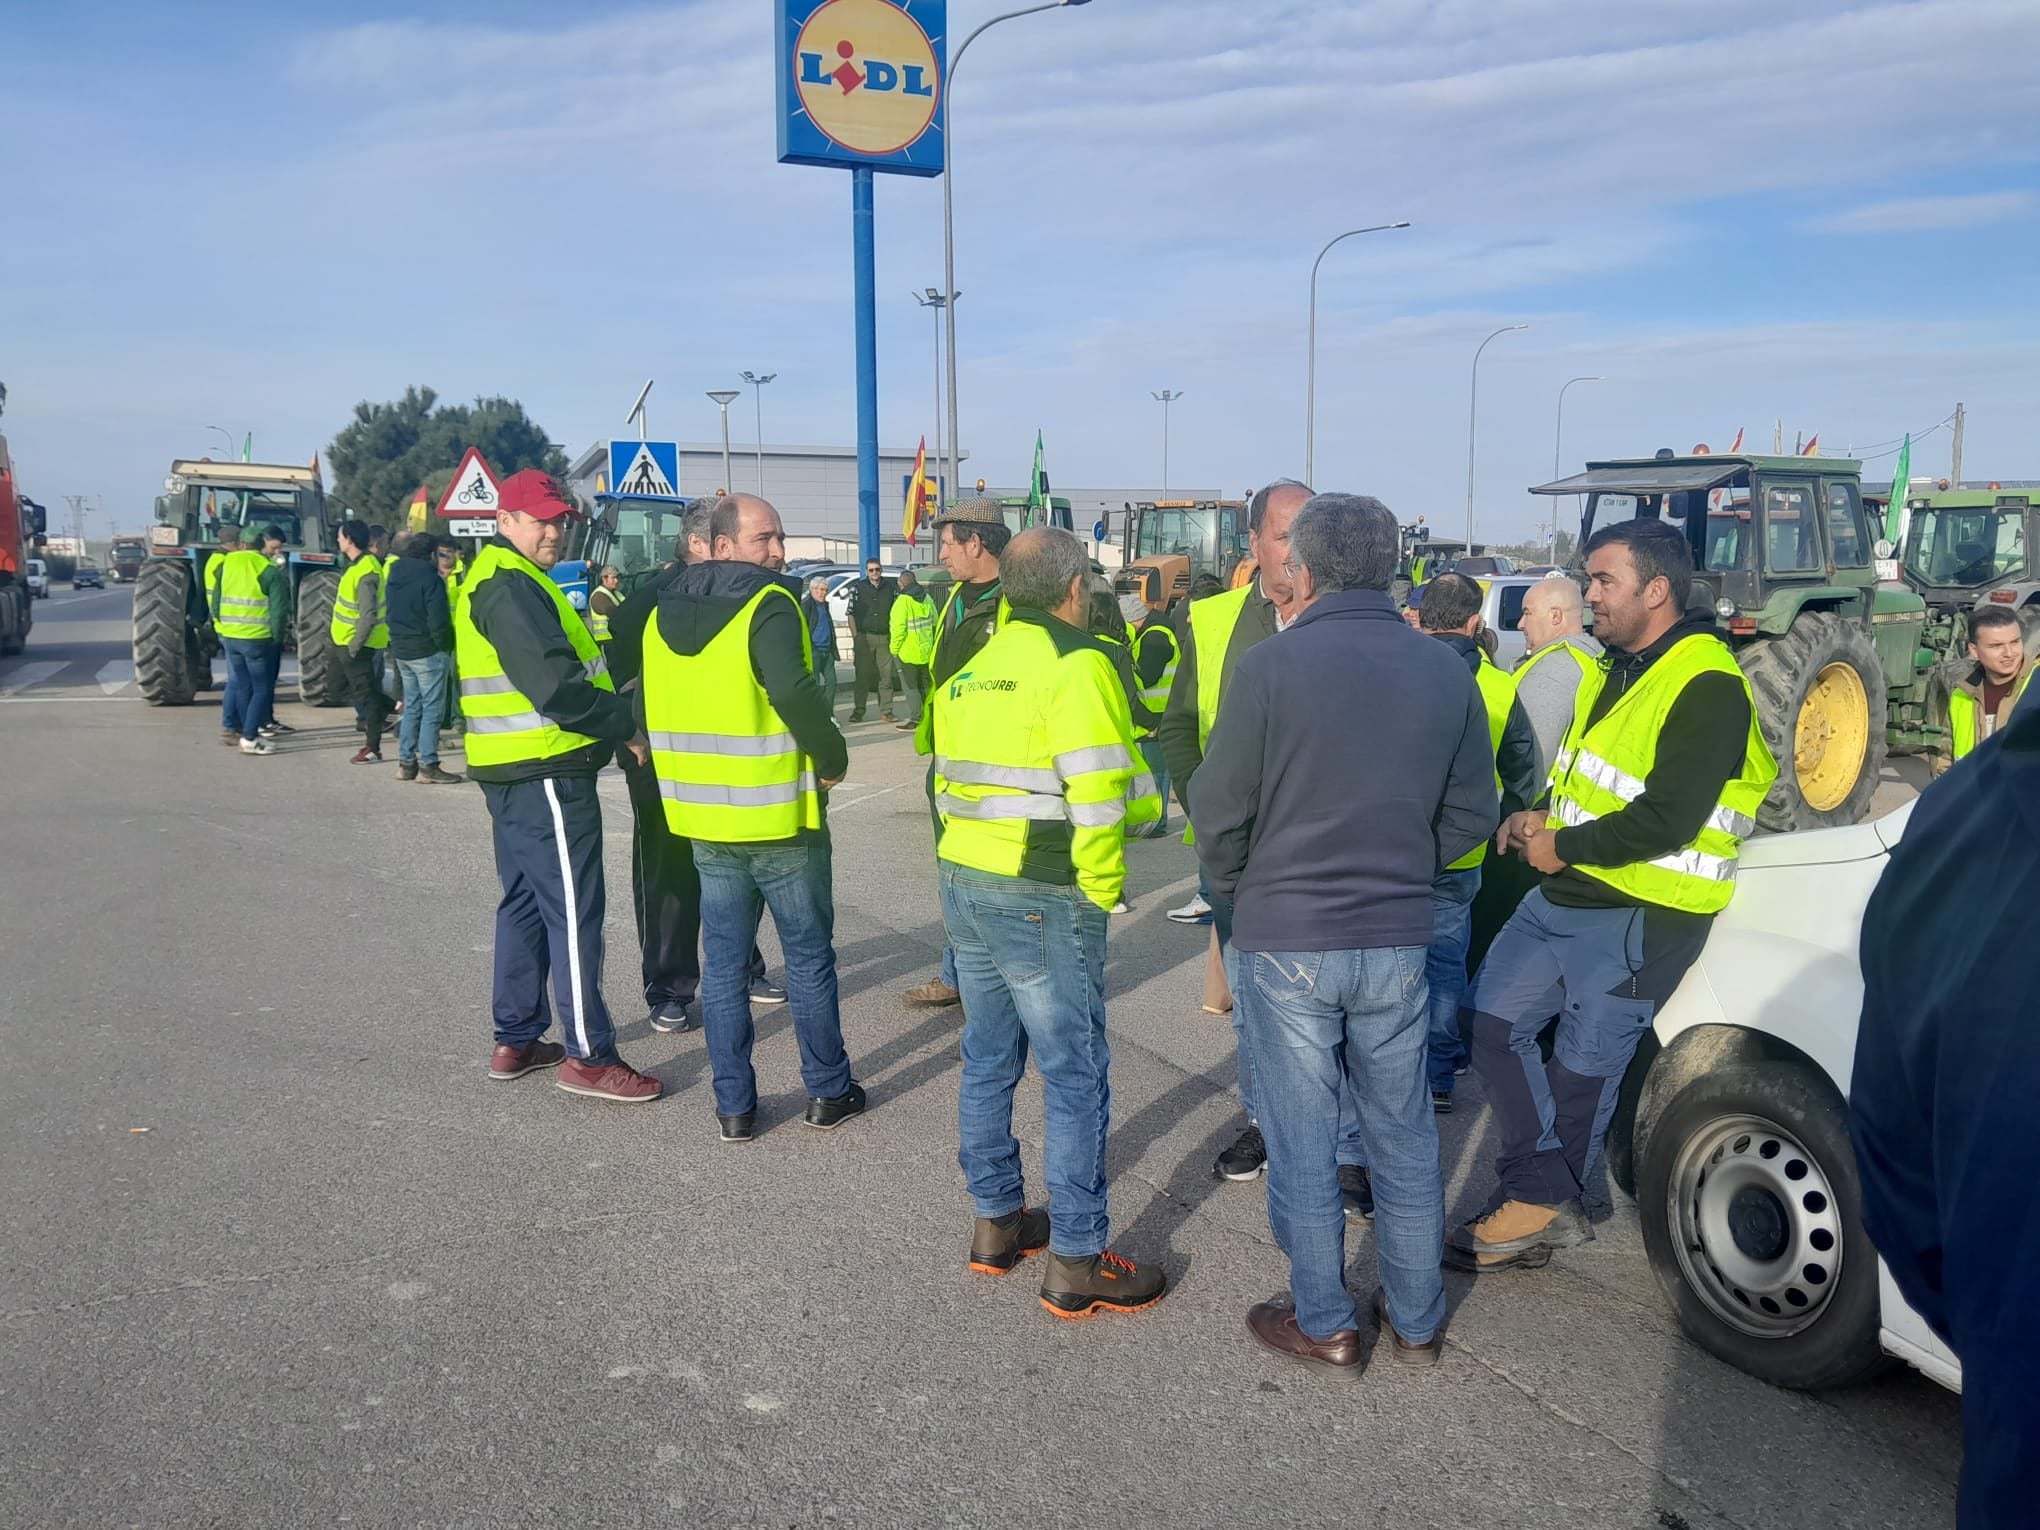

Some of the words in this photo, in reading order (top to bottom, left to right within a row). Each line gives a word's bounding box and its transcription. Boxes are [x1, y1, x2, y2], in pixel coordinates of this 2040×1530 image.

[800, 40, 932, 96] LIDL
[1880, 542, 1889, 557] 40
[966, 679, 1018, 692] TECNOURBS
